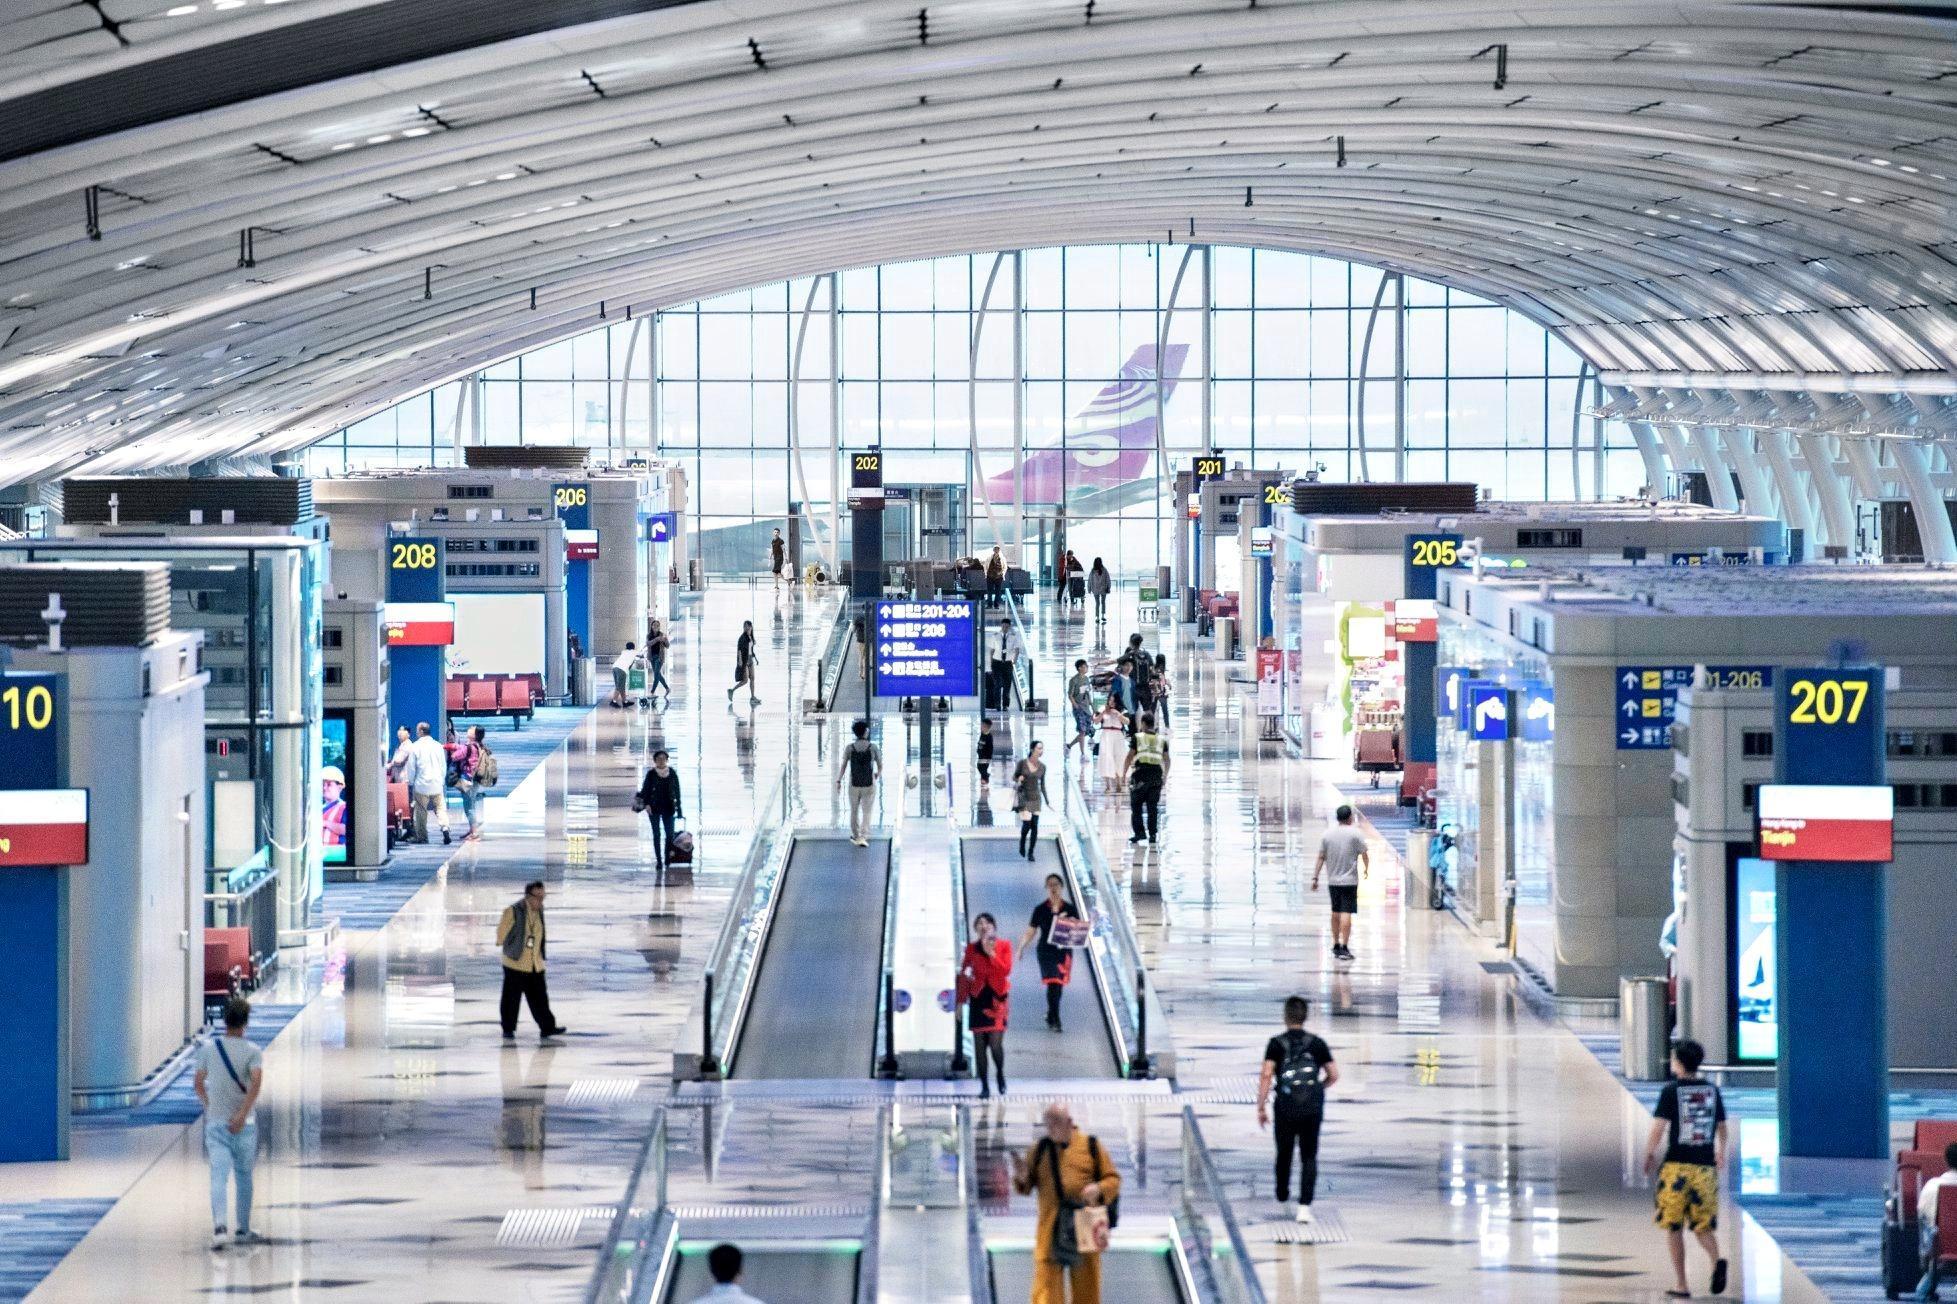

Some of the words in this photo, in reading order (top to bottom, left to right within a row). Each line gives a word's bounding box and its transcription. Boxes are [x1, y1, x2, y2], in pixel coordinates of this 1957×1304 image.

[855, 456, 878, 470] 202
[1198, 460, 1221, 475] 201
[556, 488, 586, 506] 206
[1264, 485, 1291, 504] 20
[392, 543, 436, 569] 208
[1412, 540, 1457, 566] 205
[921, 604, 970, 618] 201-204
[1690, 670, 1763, 690] 01-206
[1790, 680, 1869, 724] 207
